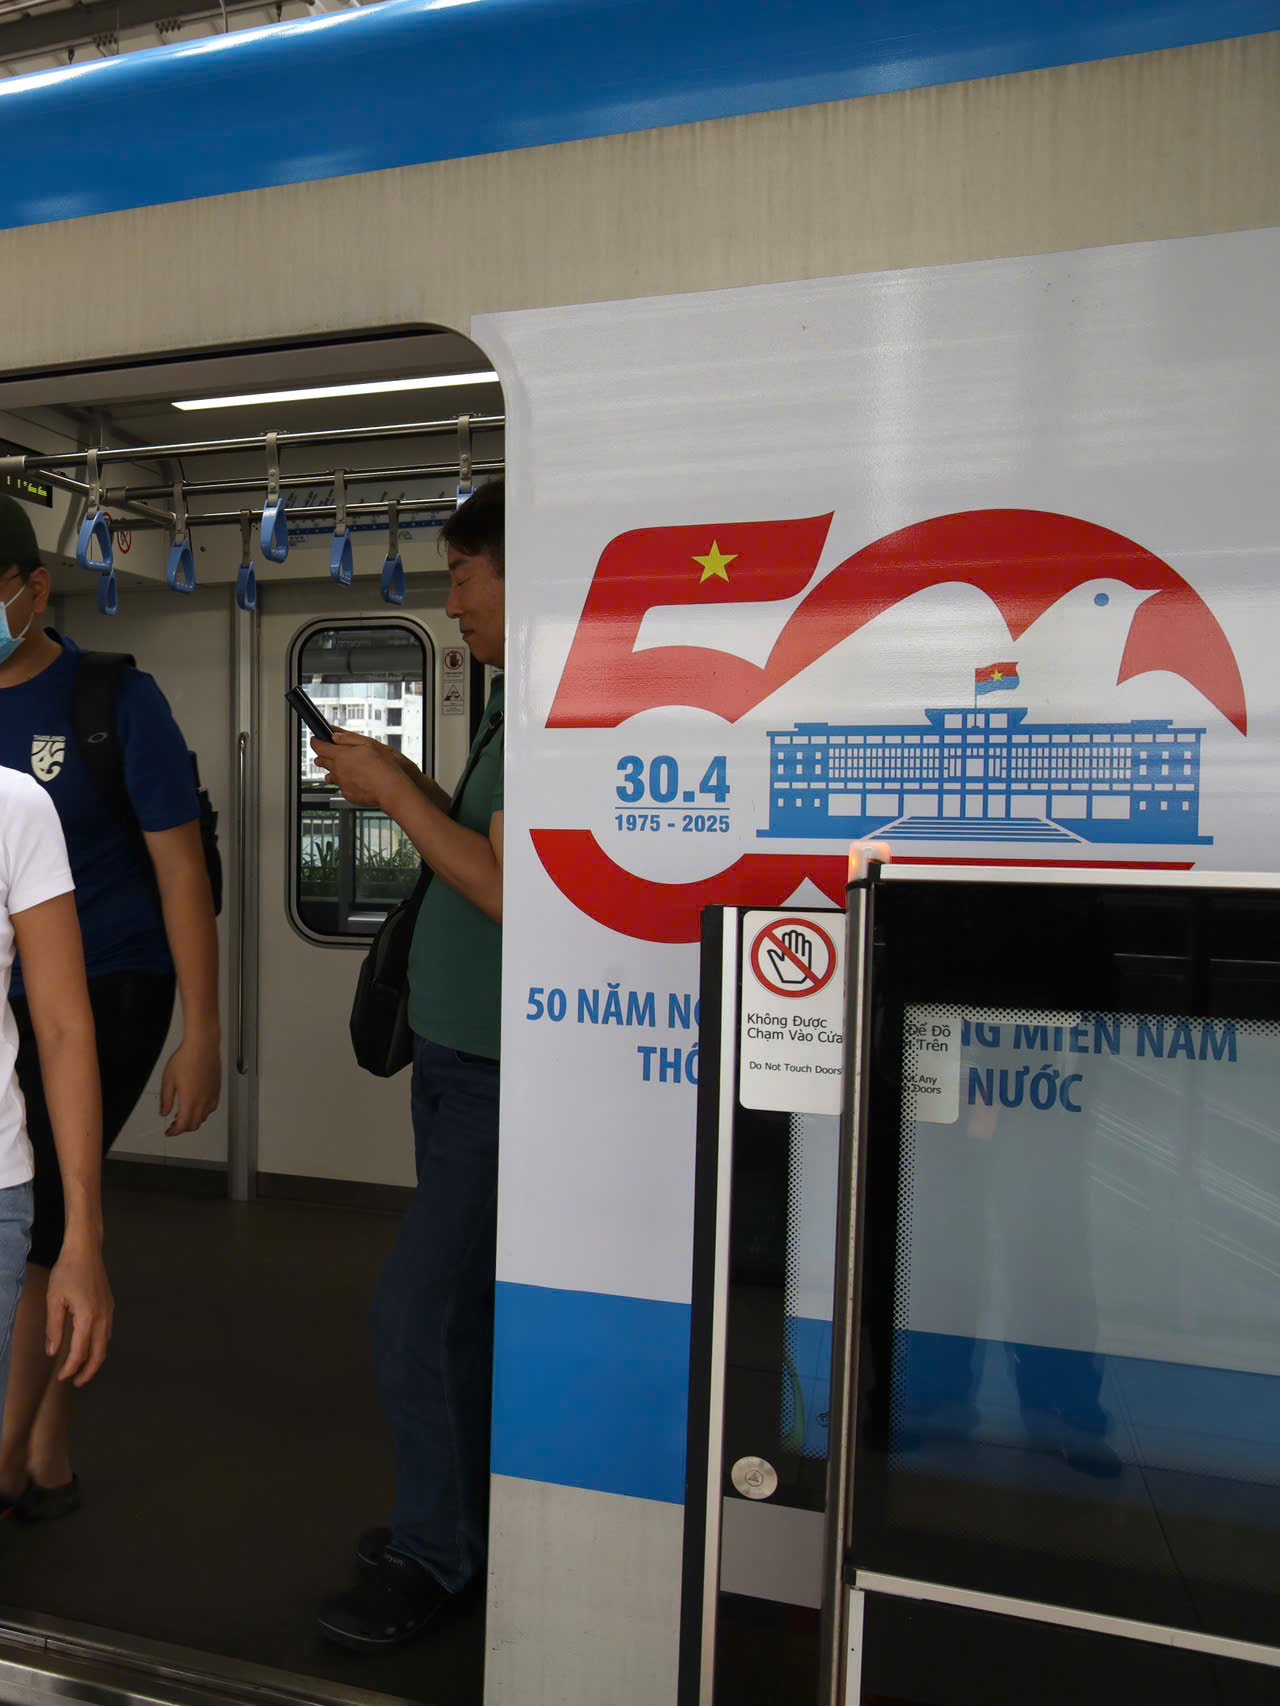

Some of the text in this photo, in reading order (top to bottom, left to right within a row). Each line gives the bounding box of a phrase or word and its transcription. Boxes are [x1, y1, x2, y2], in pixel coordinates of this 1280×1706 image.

[616, 755, 730, 803] 30.4
[615, 814, 661, 831] 1975
[682, 815, 730, 833] 2025
[526, 982, 700, 1029] 50 NĂM N
[747, 1013, 827, 1030] Không Được
[747, 1027, 843, 1043] Chạm Vào Cửa
[1136, 1017, 1237, 1062] NAM
[918, 1039, 948, 1051] Trên
[749, 1061, 842, 1075] Do Not Touch Doors
[919, 1075, 937, 1085] Any
[968, 1064, 1083, 1112] NƯỚC
